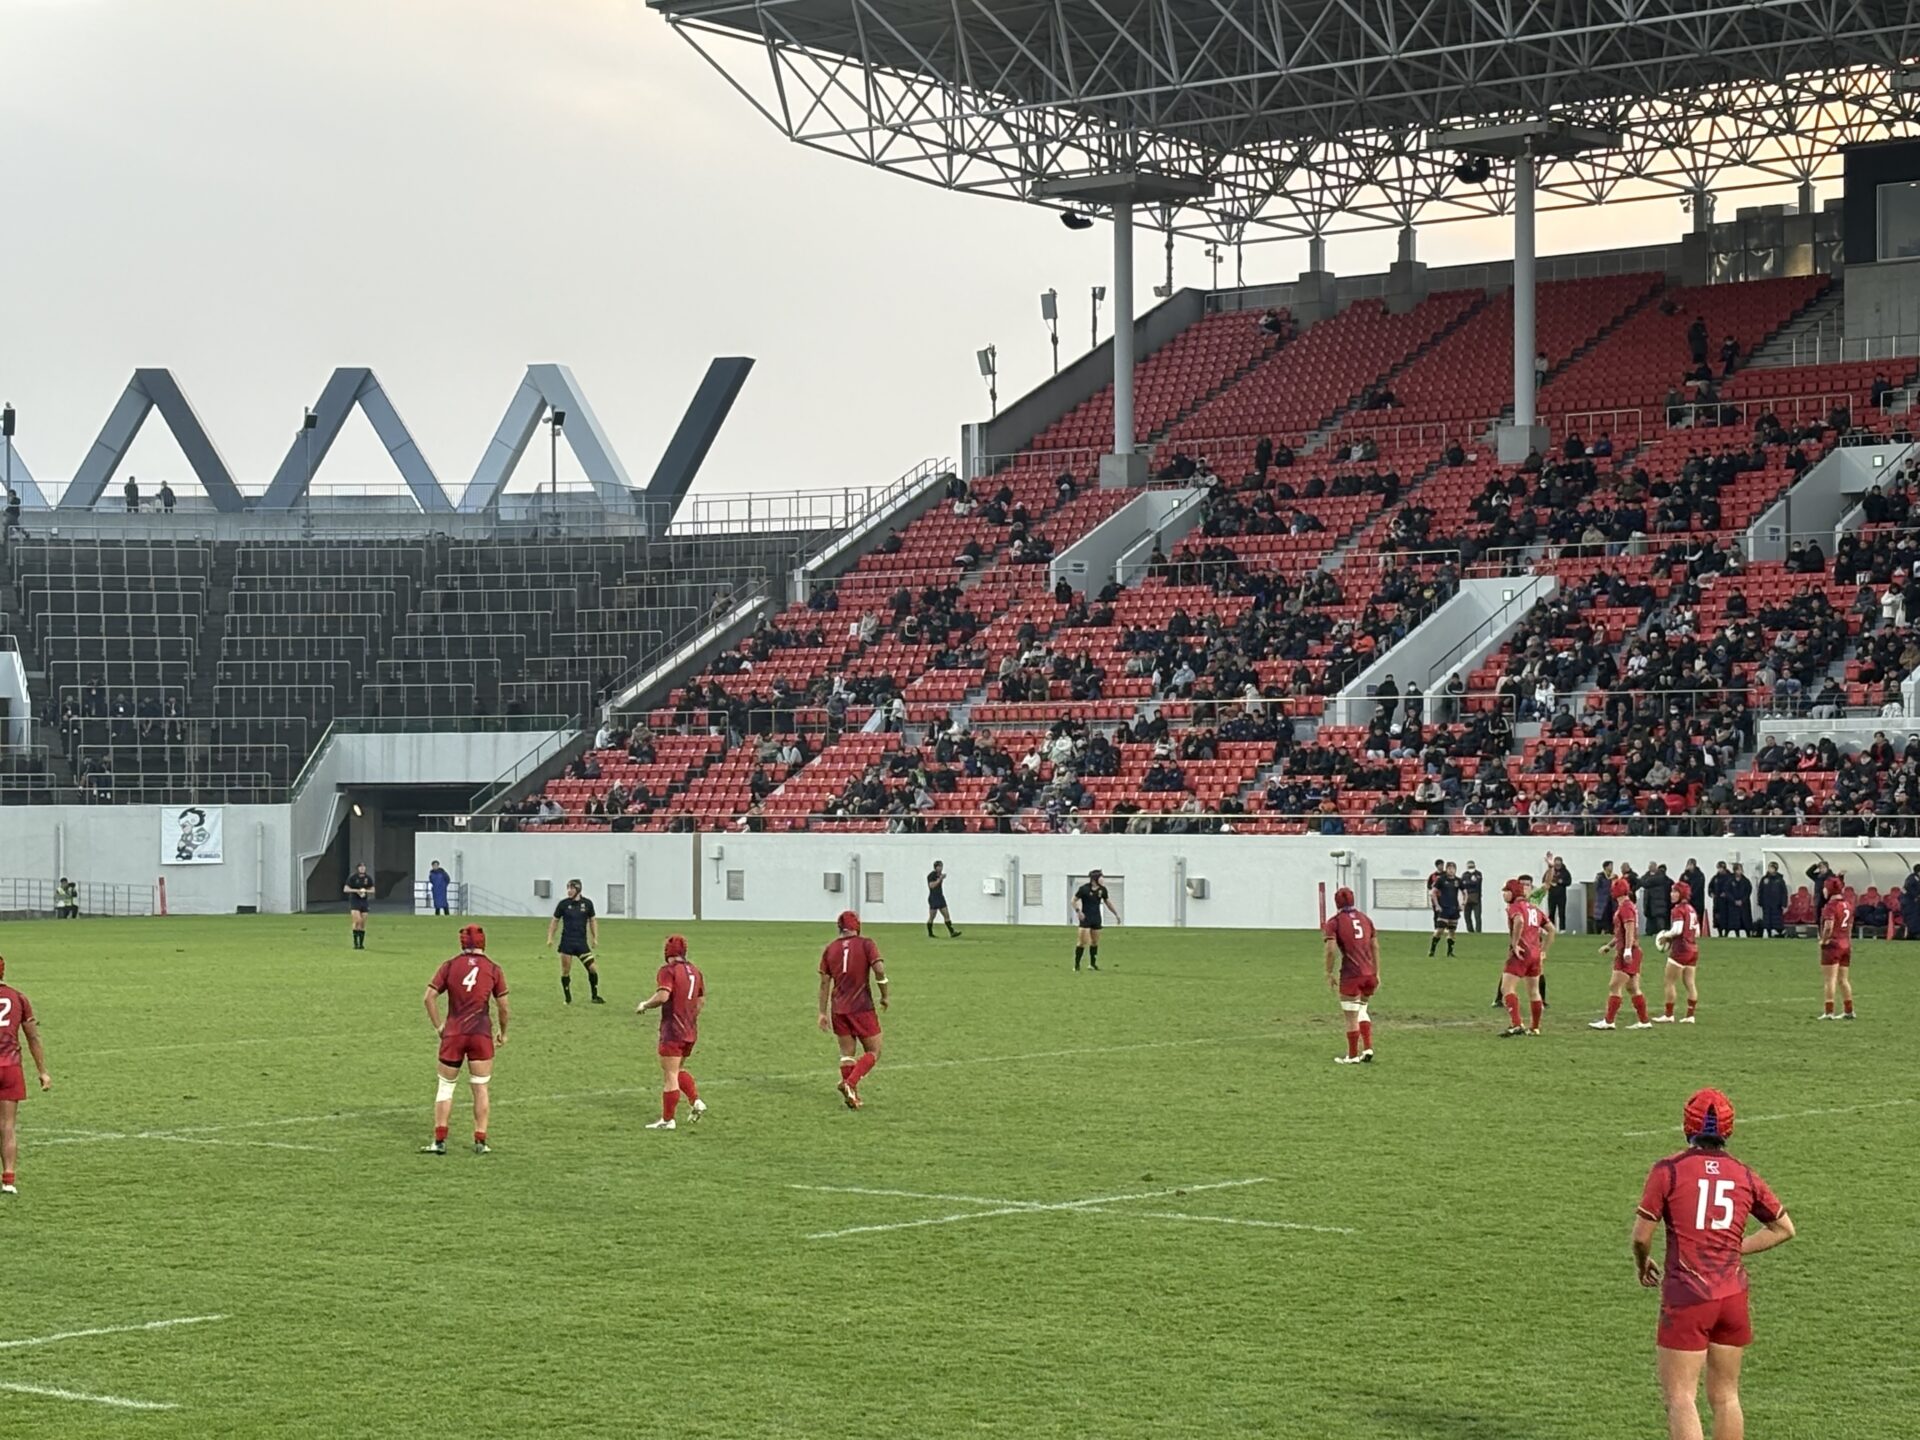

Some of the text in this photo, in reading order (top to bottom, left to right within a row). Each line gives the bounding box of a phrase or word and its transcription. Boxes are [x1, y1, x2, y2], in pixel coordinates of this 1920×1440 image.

[1352, 919, 1364, 939] 5
[1841, 909, 1850, 928] 2
[842, 948, 850, 973] 1
[462, 966, 479, 992] 4
[1696, 1178, 1736, 1230] 15
